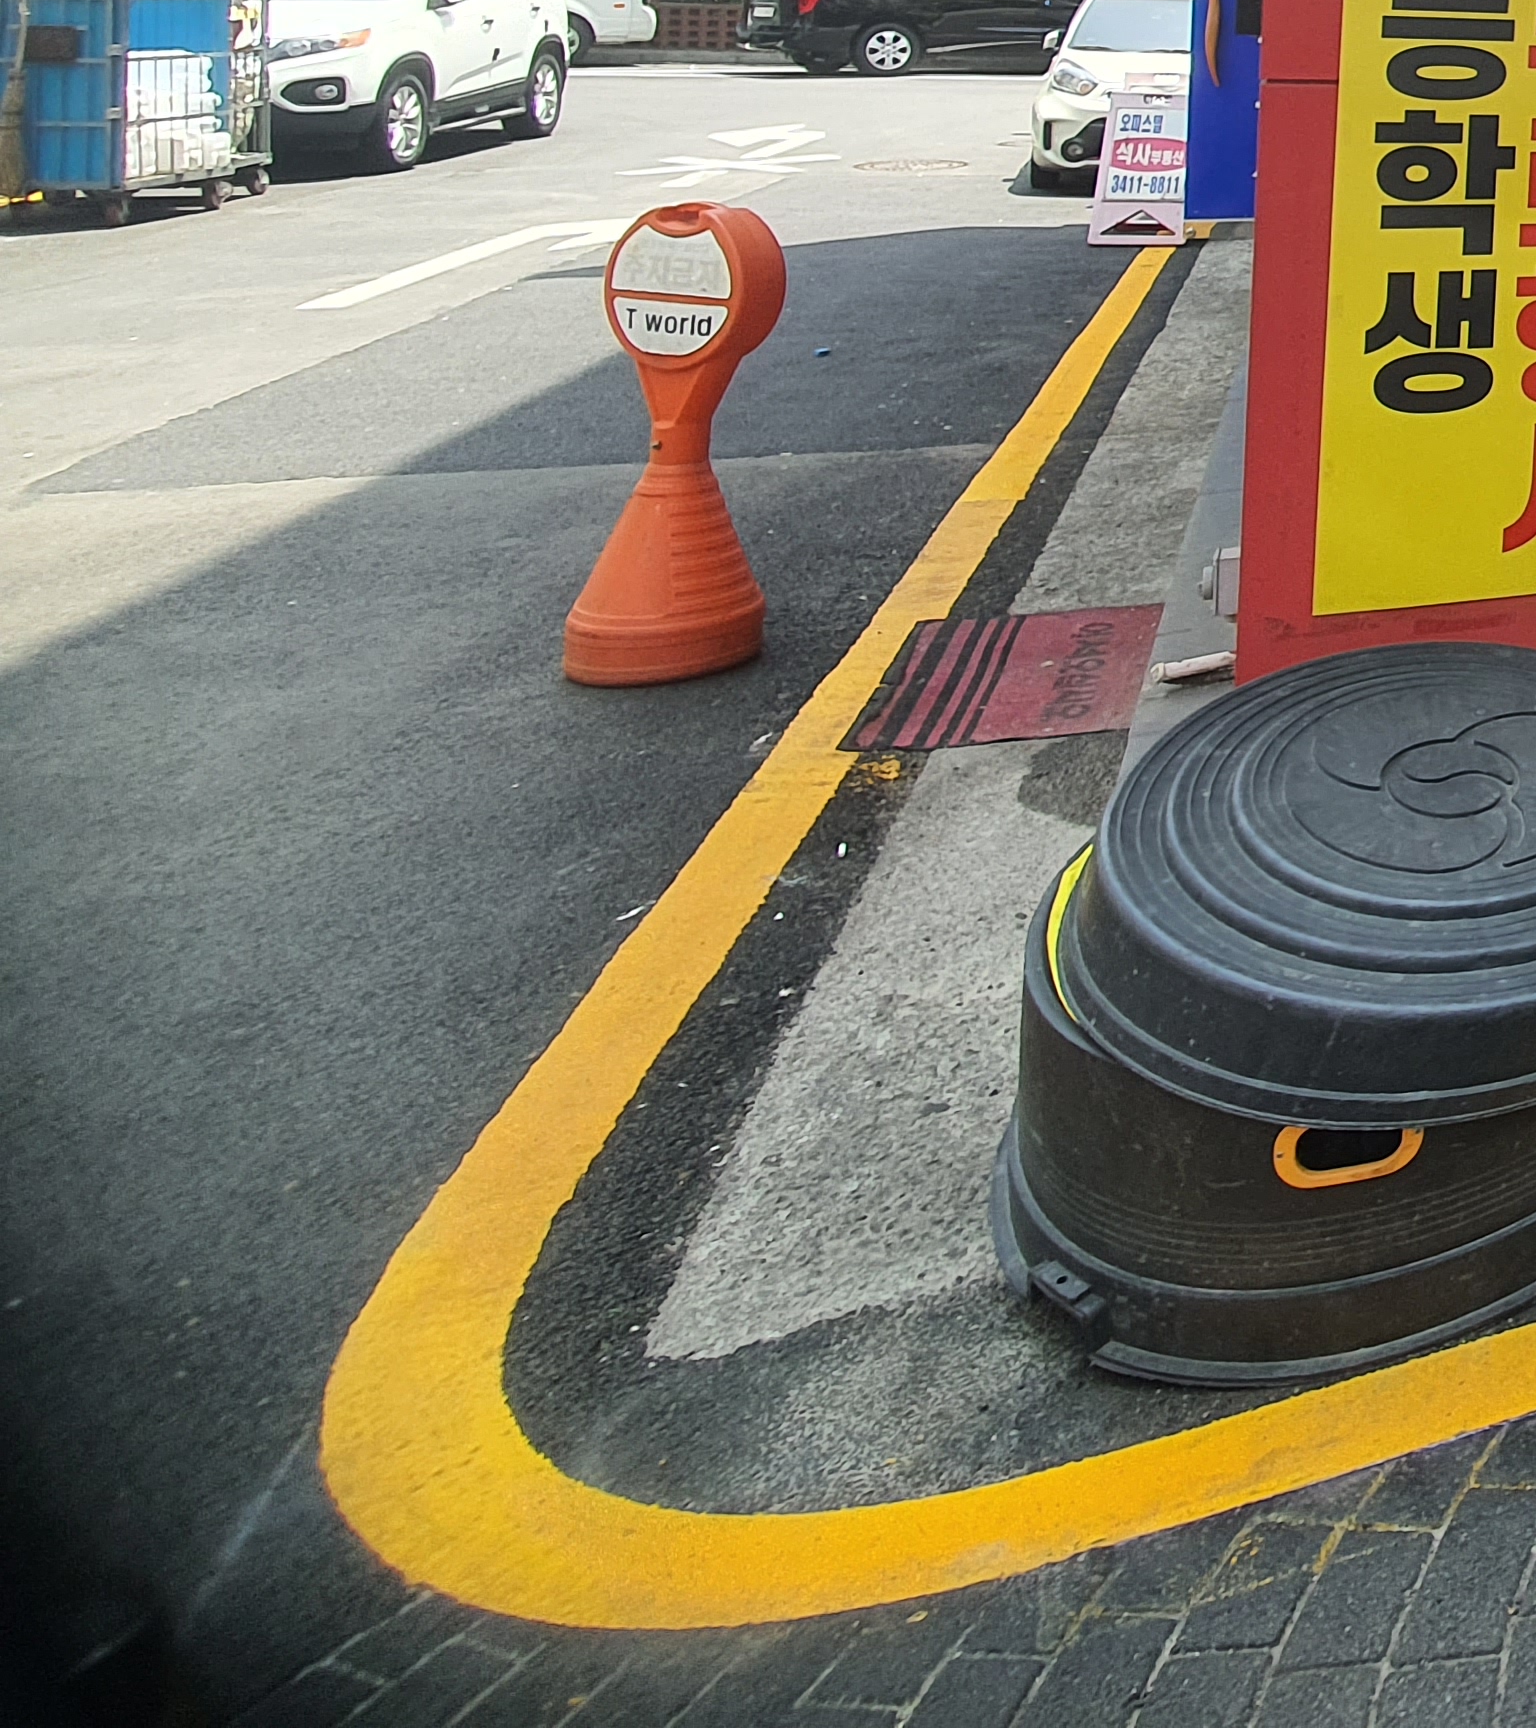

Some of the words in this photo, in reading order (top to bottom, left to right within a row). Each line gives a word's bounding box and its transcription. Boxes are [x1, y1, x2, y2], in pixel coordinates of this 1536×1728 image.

[1111, 175, 1180, 194] 3411-8811
[626, 308, 637, 329] T
[646, 314, 712, 337] world
